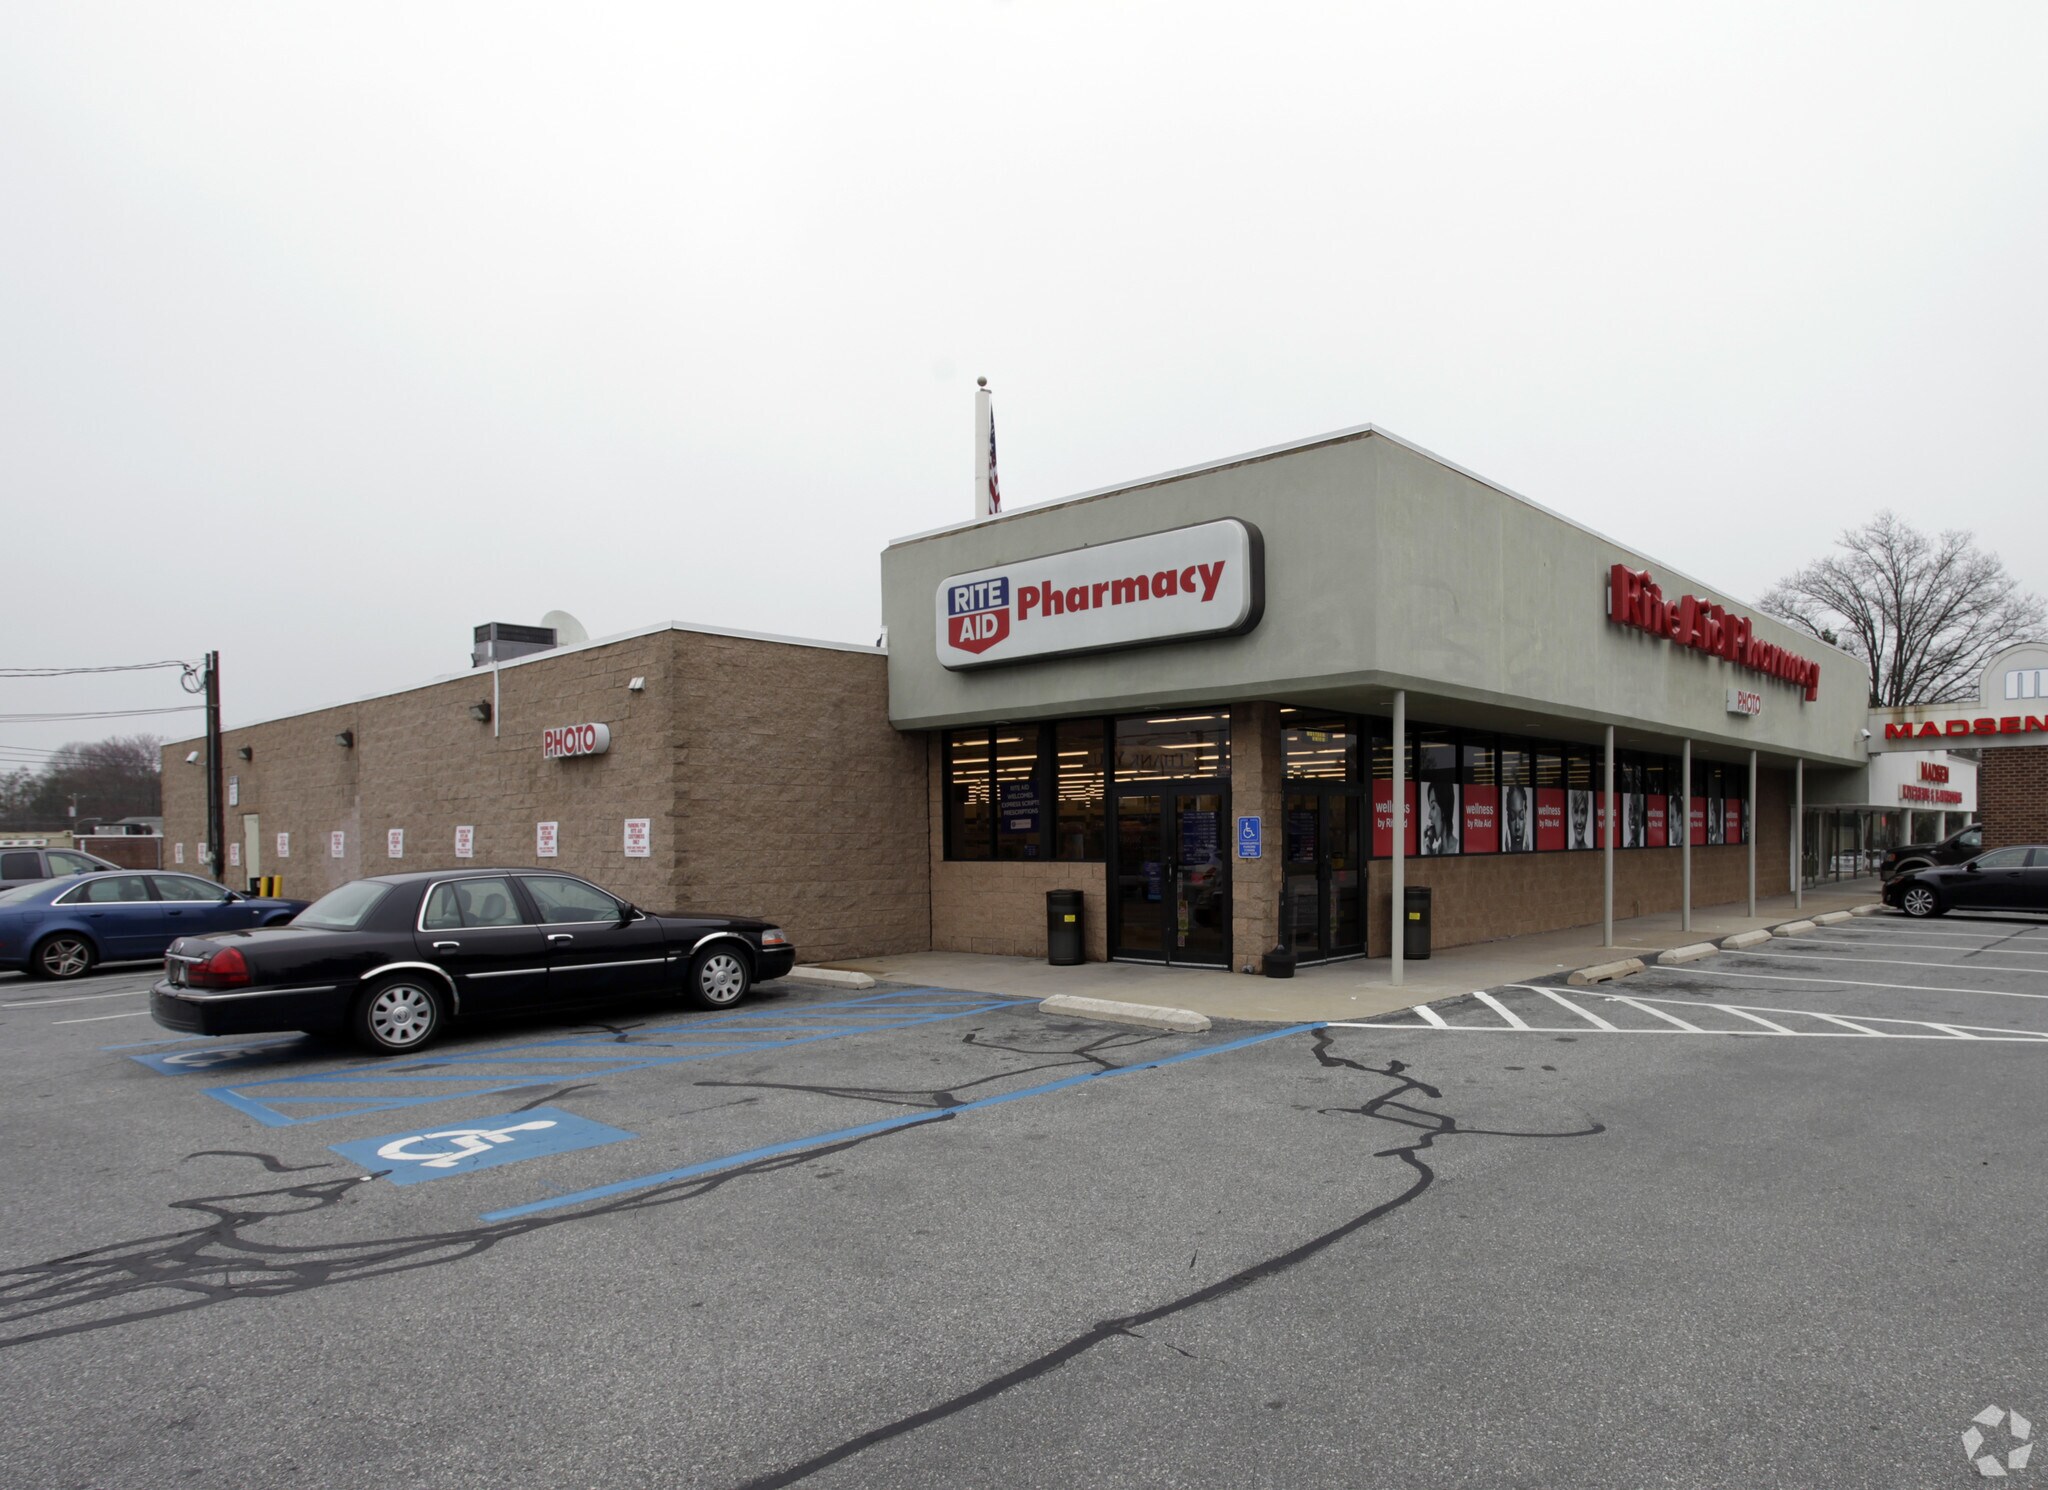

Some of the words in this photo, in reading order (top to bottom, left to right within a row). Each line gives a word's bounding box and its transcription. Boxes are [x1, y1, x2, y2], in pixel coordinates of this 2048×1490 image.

[954, 579, 1003, 614] RITE
[1017, 560, 1226, 621] Pharmacy
[959, 613, 999, 643] AID
[1737, 690, 1761, 714] PHOTO
[1885, 714, 2048, 740] MADSEN
[544, 724, 596, 757] PHOTO
[1921, 761, 1949, 783] MADSEN
[1375, 800, 1411, 814] wells
[1466, 802, 1494, 815] wellness
[1538, 804, 1561, 816] wellness
[1377, 818, 1385, 830] by
[1467, 819, 1473, 830] by
[1474, 818, 1483, 828] Rite
[1484, 819, 1492, 828] Aid
[1539, 819, 1544, 829] by
